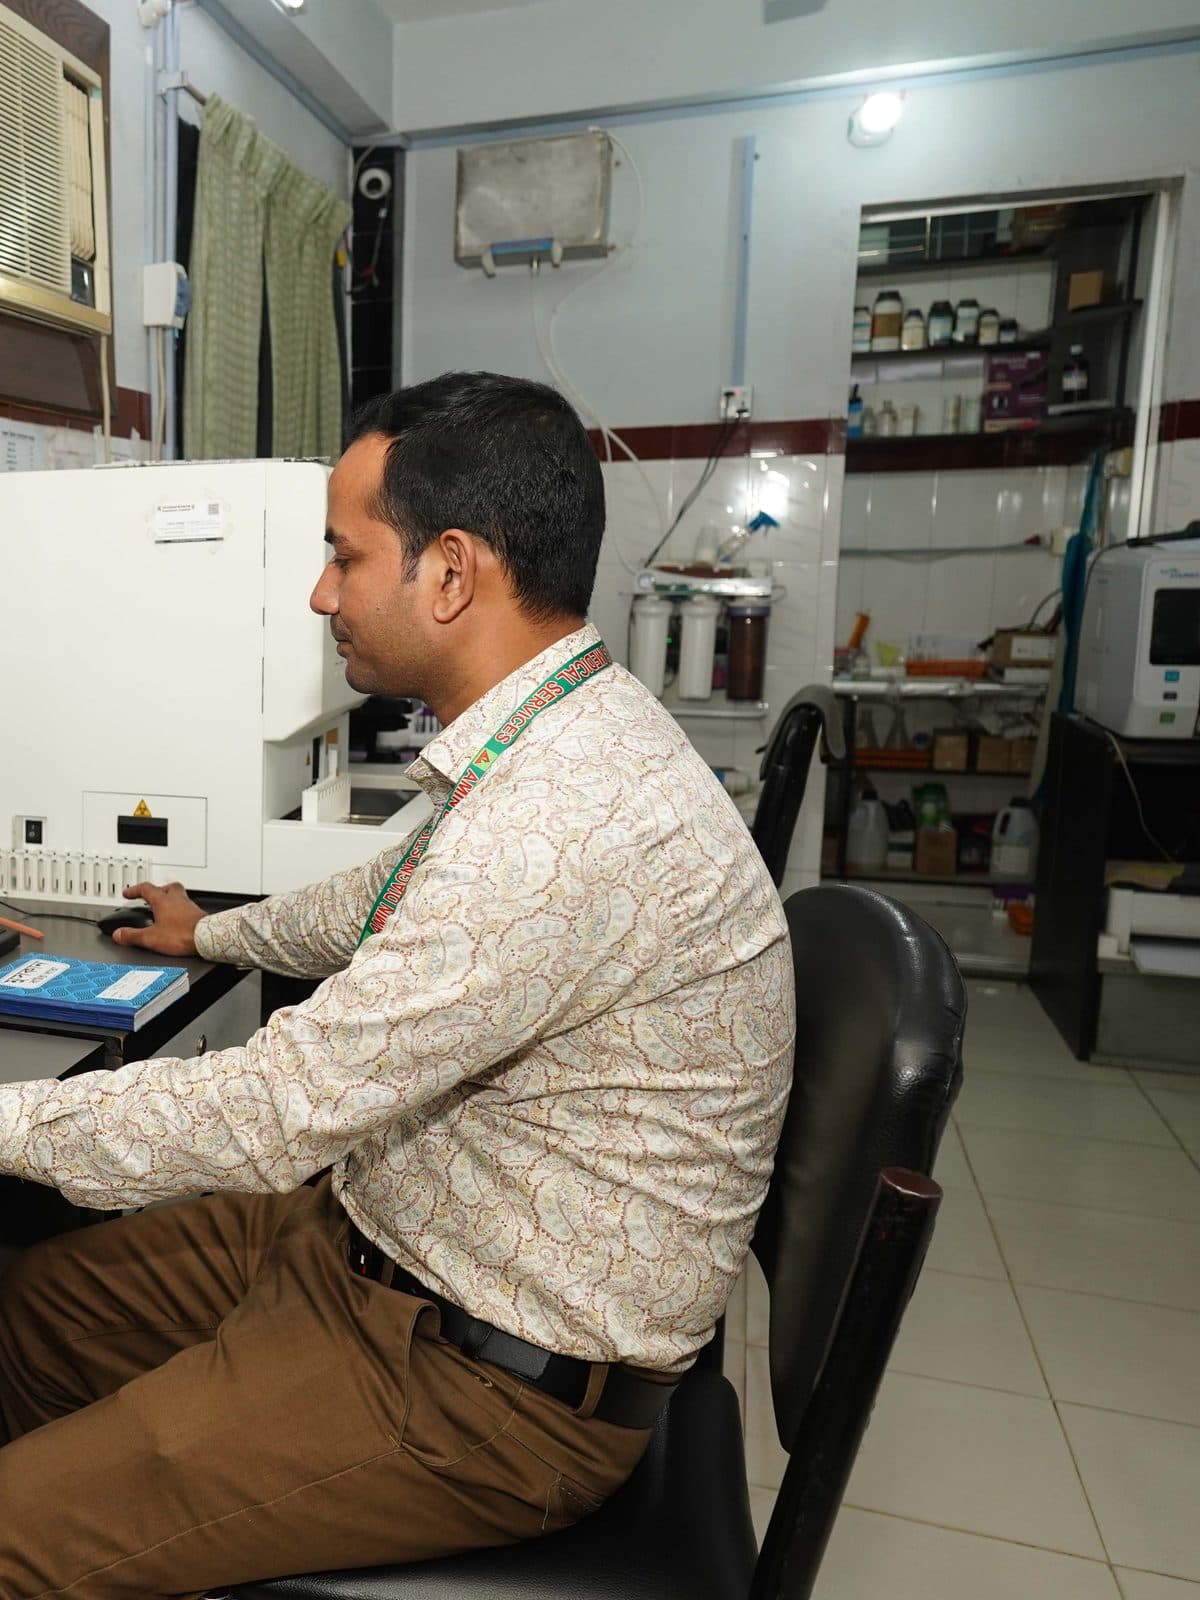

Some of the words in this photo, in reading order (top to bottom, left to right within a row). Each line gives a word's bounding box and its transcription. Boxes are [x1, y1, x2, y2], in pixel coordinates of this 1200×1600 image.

[495, 681, 564, 744] SERVICES
[448, 769, 479, 808] AMIN
[370, 903, 396, 934] AMIN
[383, 825, 433, 904] DIAGNOSTIC
